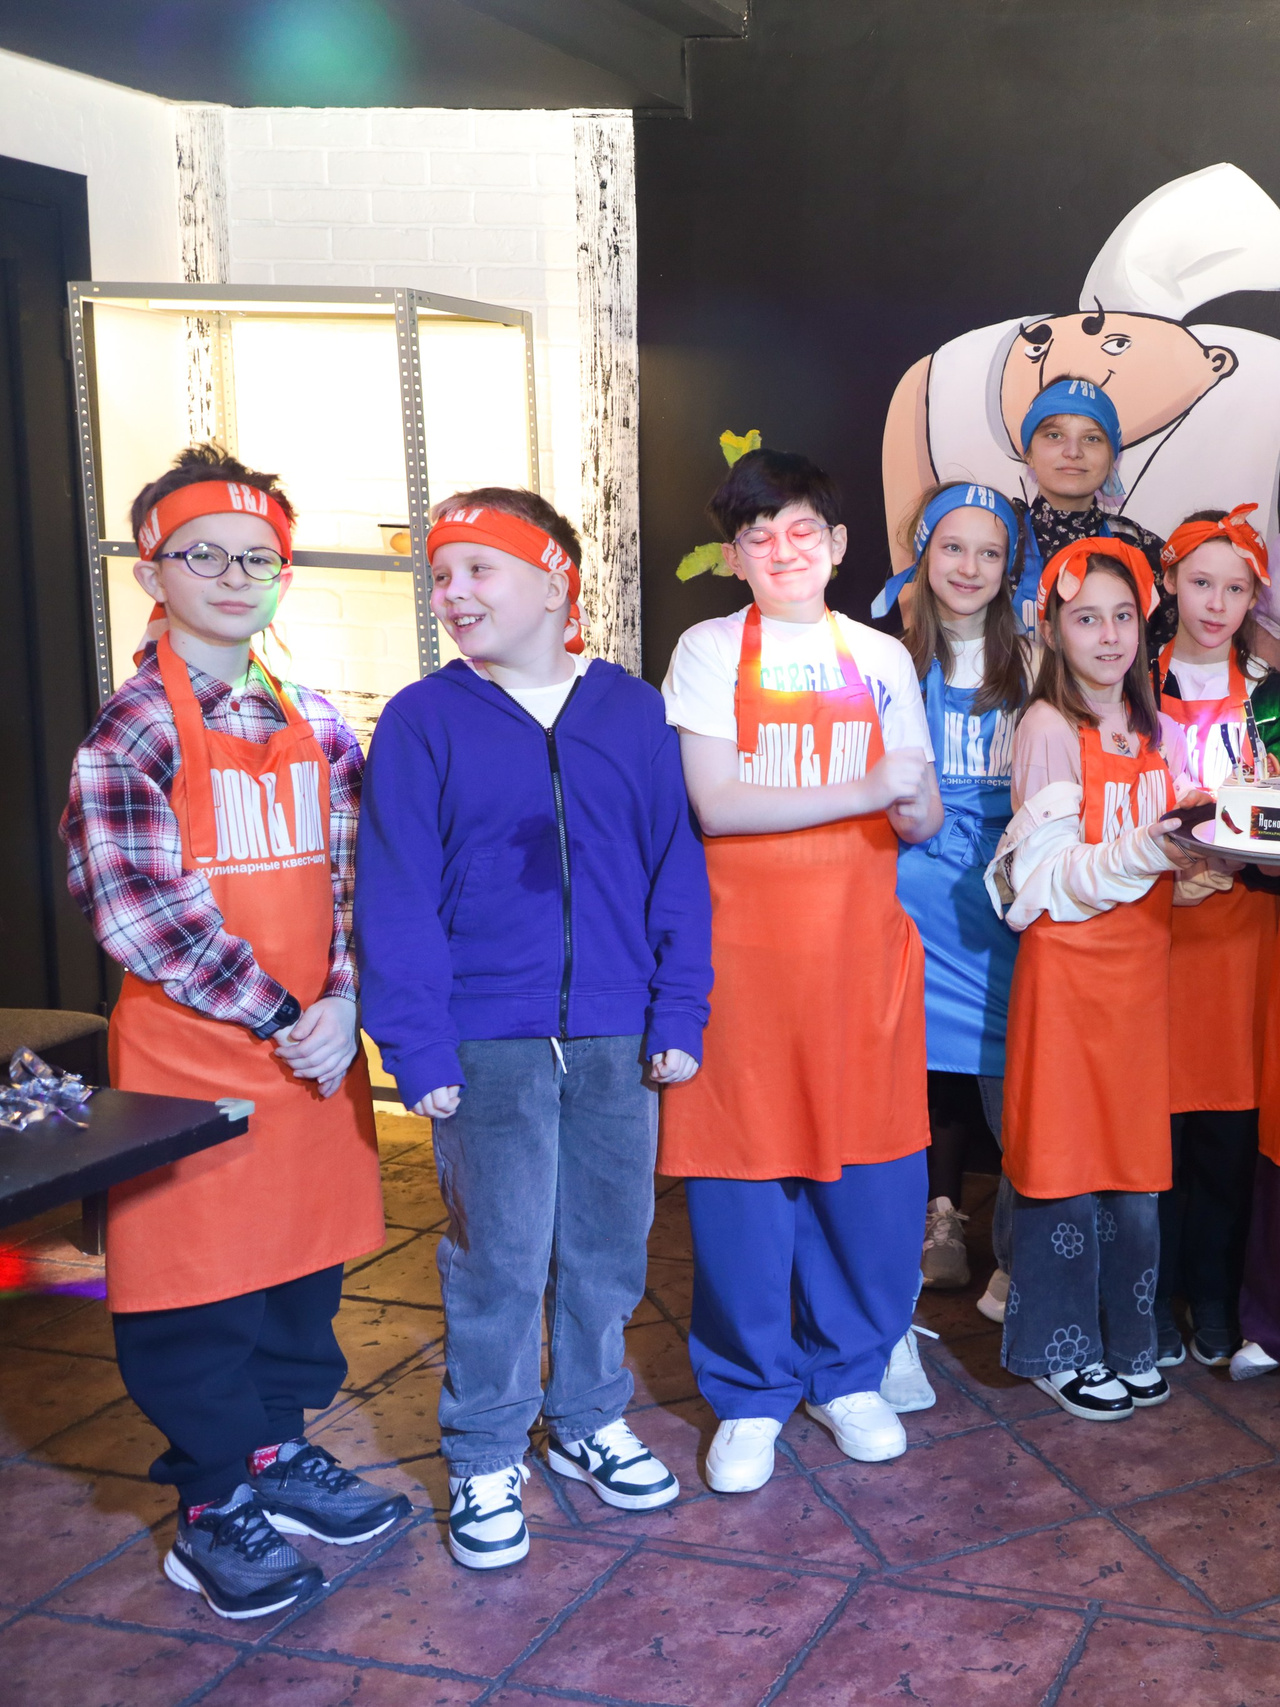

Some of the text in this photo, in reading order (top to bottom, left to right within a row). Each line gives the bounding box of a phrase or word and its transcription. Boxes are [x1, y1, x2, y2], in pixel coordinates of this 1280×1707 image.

[227, 482, 268, 516] C&R
[827, 721, 872, 785] RUN
[196, 768, 270, 863] OOK
[290, 761, 325, 854] RUN
